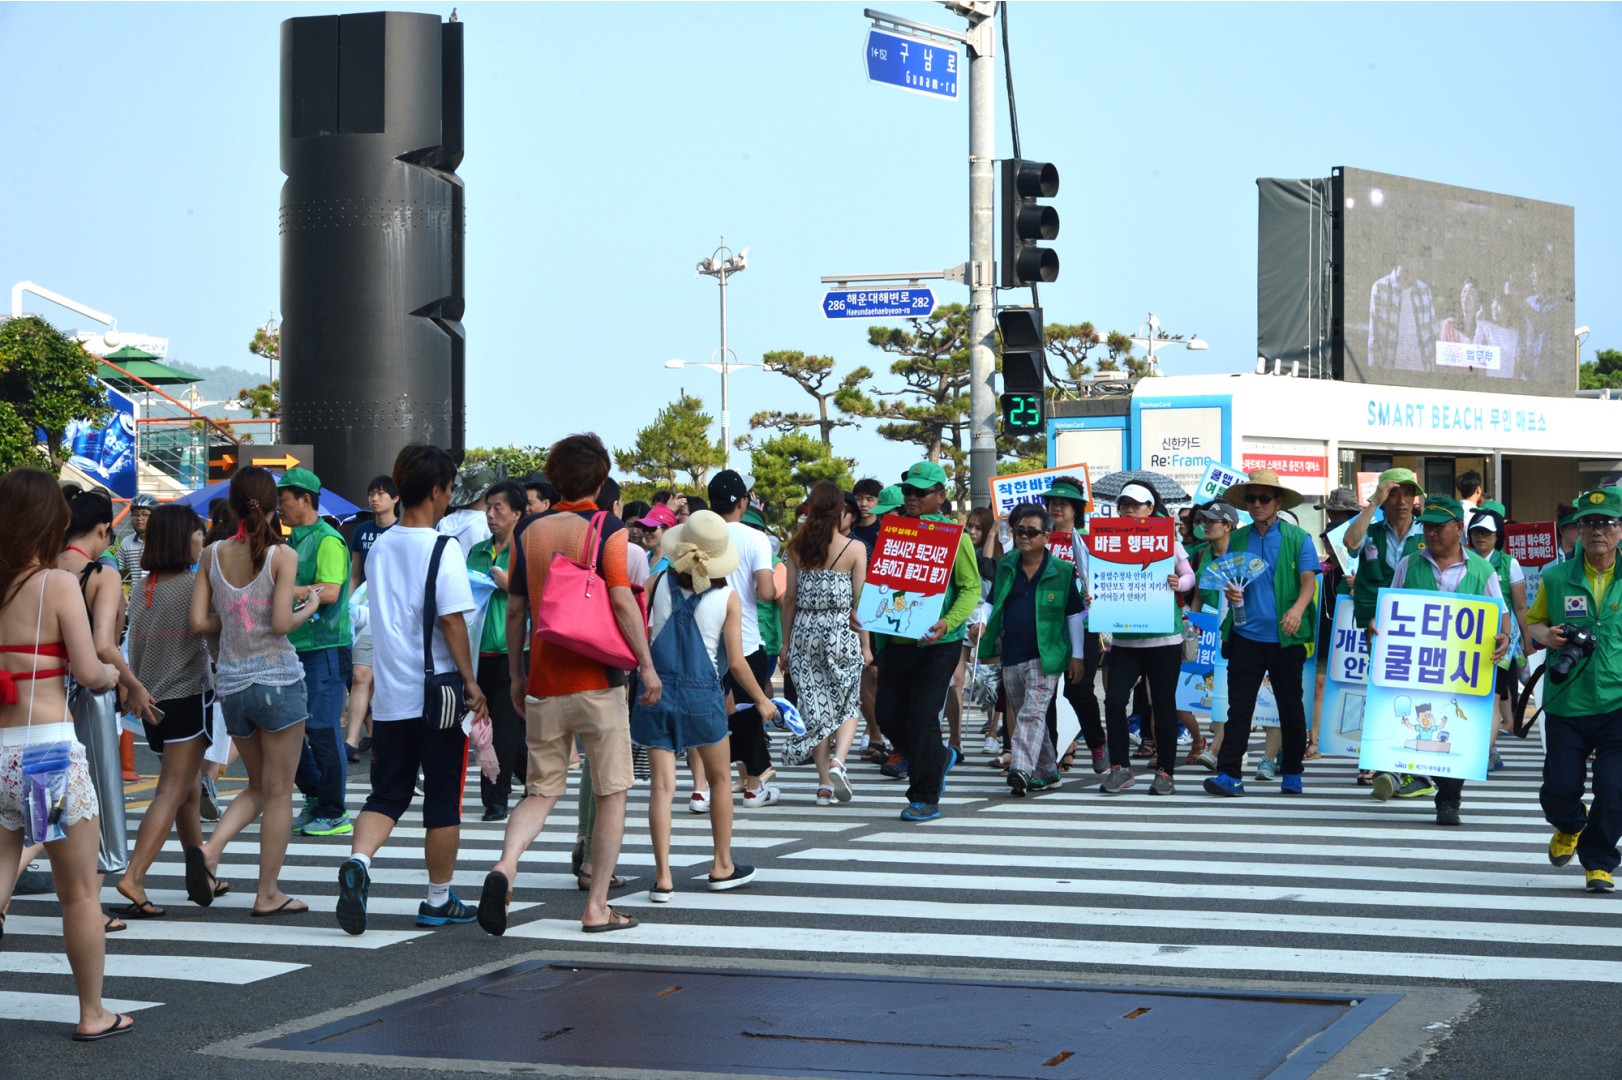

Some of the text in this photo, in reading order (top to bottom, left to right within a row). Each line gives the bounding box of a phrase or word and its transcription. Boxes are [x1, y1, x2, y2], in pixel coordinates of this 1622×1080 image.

[899, 42, 956, 73] 구남로
[905, 70, 956, 94] Gunam-ro
[827, 299, 846, 311] 286
[846, 291, 911, 307] 해운대해변로
[912, 297, 930, 308] 282
[846, 307, 911, 316] Haeundaehaebyeon-ro
[1367, 400, 1425, 428] SMART
[1431, 404, 1483, 431] BEACH
[1490, 408, 1512, 432] 무인
[1161, 437, 1201, 450] 신한카드
[1210, 468, 1244, 487] 쿨맵
[884, 526, 918, 536] 사무실에서
[1094, 535, 1168, 552] 바른 행락지
[1527, 533, 1551, 546] 해수욕장
[883, 538, 948, 564] 점심시간 퇴근시간
[872, 558, 905, 578] 소등하고
[1100, 571, 1153, 581] 불법주정차 안하기
[1100, 581, 1168, 591] 횡단보도 정지선 지키기
[1100, 592, 1147, 602] 끼어들기 안하기
[1387, 601, 1485, 645] 노타이
[1344, 656, 1371, 680] 안
[1385, 644, 1480, 688] 쿨맵시
